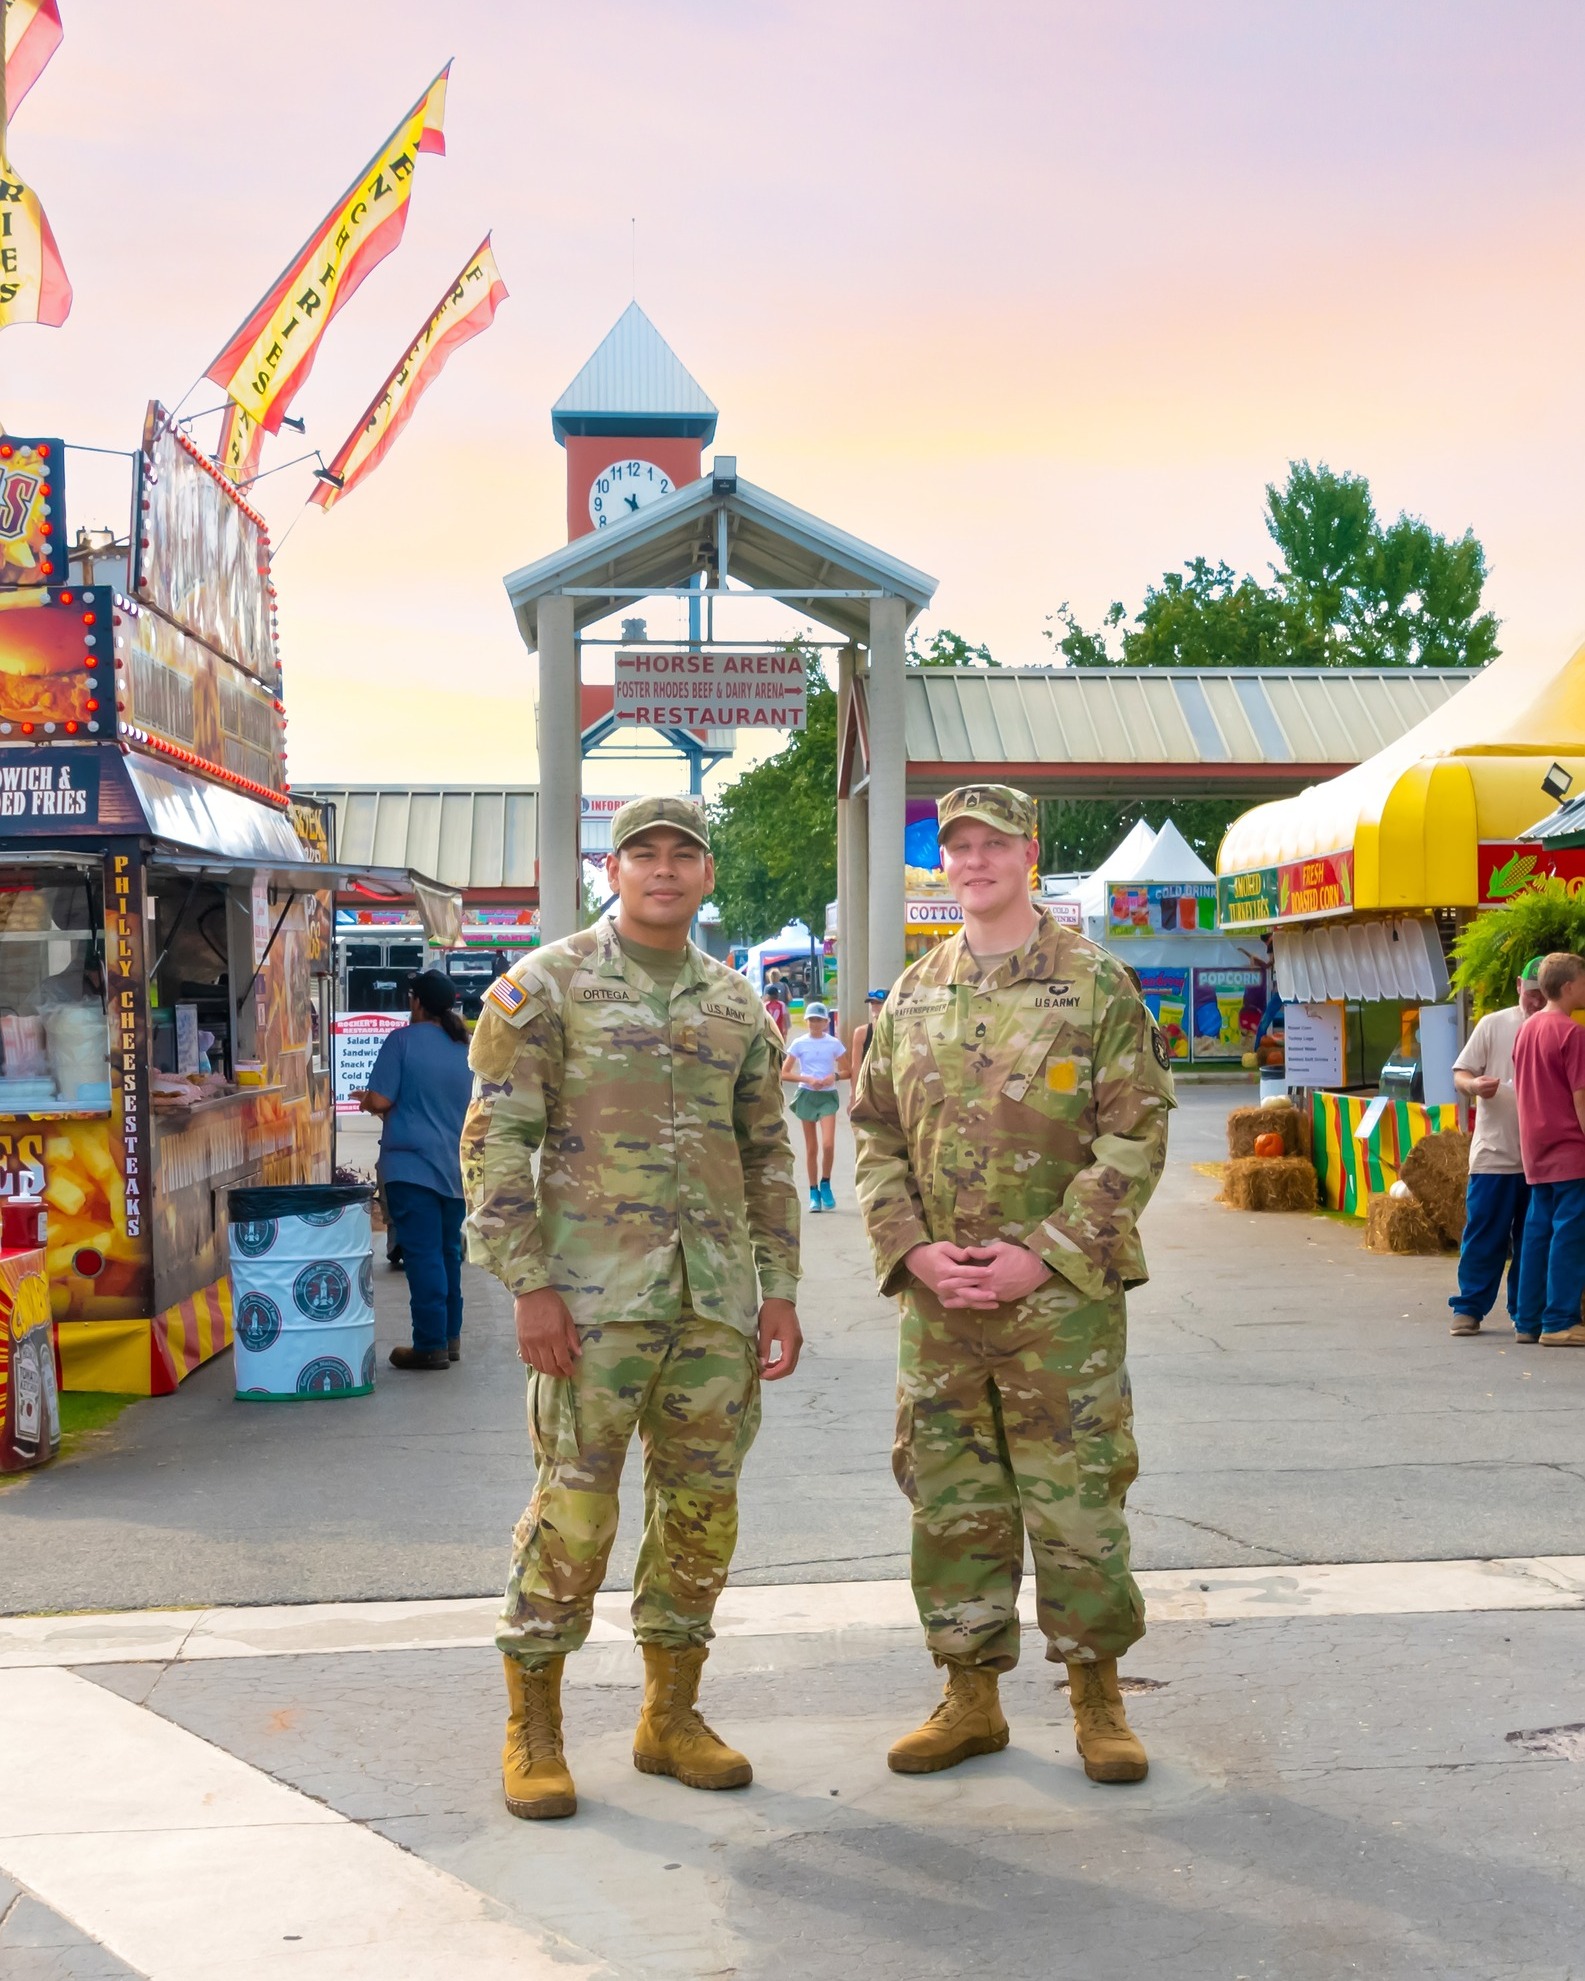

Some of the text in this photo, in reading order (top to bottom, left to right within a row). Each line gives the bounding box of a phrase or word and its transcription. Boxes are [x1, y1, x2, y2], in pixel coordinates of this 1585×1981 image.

[0, 165, 24, 303] RIES
[252, 262, 336, 395] FRIES
[610, 466, 622, 480] 11
[626, 462, 640, 476] 12
[647, 467, 653, 481] 1
[596, 479, 609, 493] 10
[660, 479, 669, 494] 2
[594, 497, 602, 511] 9
[635, 655, 803, 675] HORSE ARENA
[616, 681, 785, 699] FOSTER RHODES BEEF & DAIRY ARENA
[635, 706, 804, 725] RESTAURANT
[0, 765, 71, 791] WICH &
[31, 790, 87, 815] FRIES
[1302, 862, 1325, 887] FRESH
[1155, 884, 1217, 900] COLD DRINK
[1290, 884, 1339, 915] ROASTED CORN
[1198, 971, 1262, 987] POPCORN
[583, 989, 630, 1000] ORTEGA
[1052, 996, 1080, 1008] ARMY
[725, 1006, 746, 1021] ARMY
[114, 855, 140, 1237] PHILLY CHEESESTEAKS
[347, 1037, 384, 1045] Salad Ba
[342, 1072, 362, 1080] Cold
